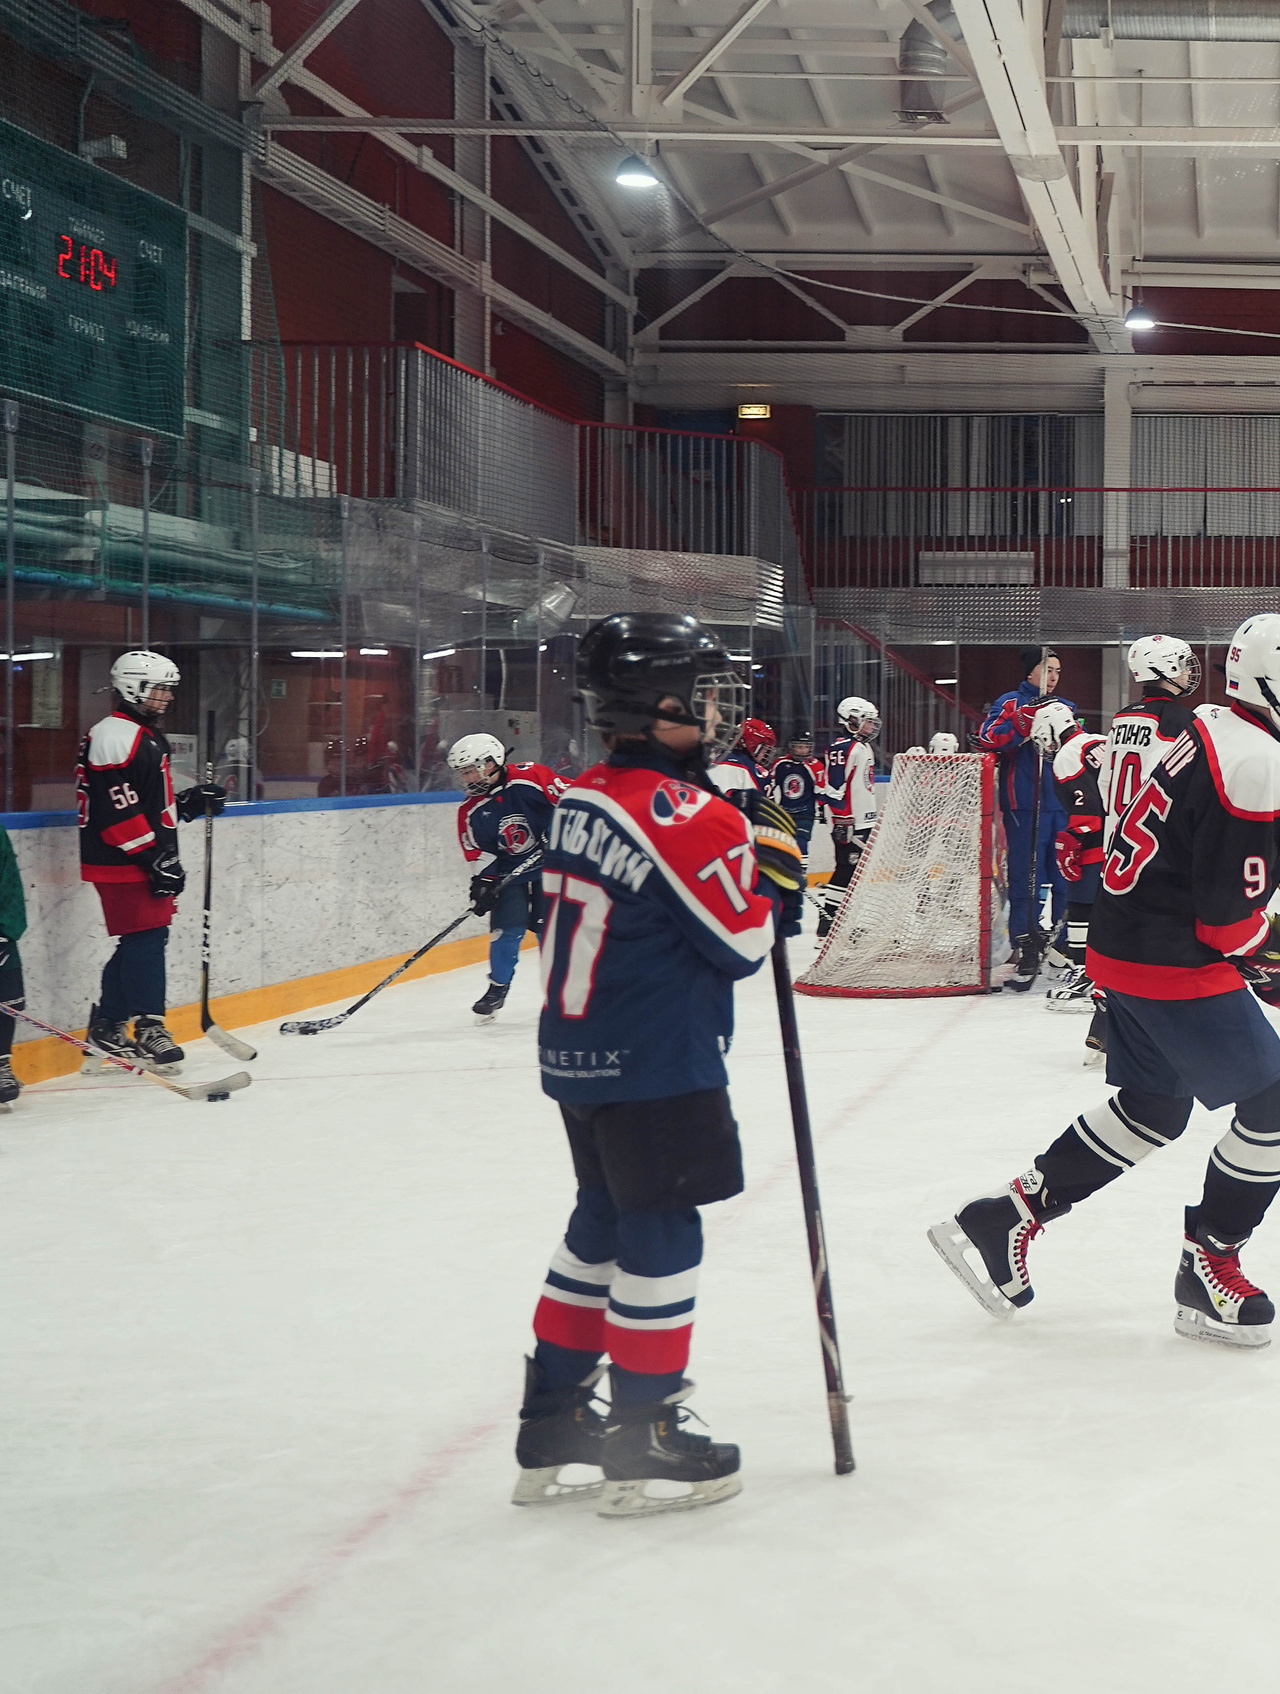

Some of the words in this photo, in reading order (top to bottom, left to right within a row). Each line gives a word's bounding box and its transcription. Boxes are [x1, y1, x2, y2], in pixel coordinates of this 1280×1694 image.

[1229, 646, 1242, 663] 95
[108, 782, 140, 810] 56
[696, 841, 757, 917] 77
[541, 868, 614, 1020] 77
[540, 1048, 621, 1067] NETIX
